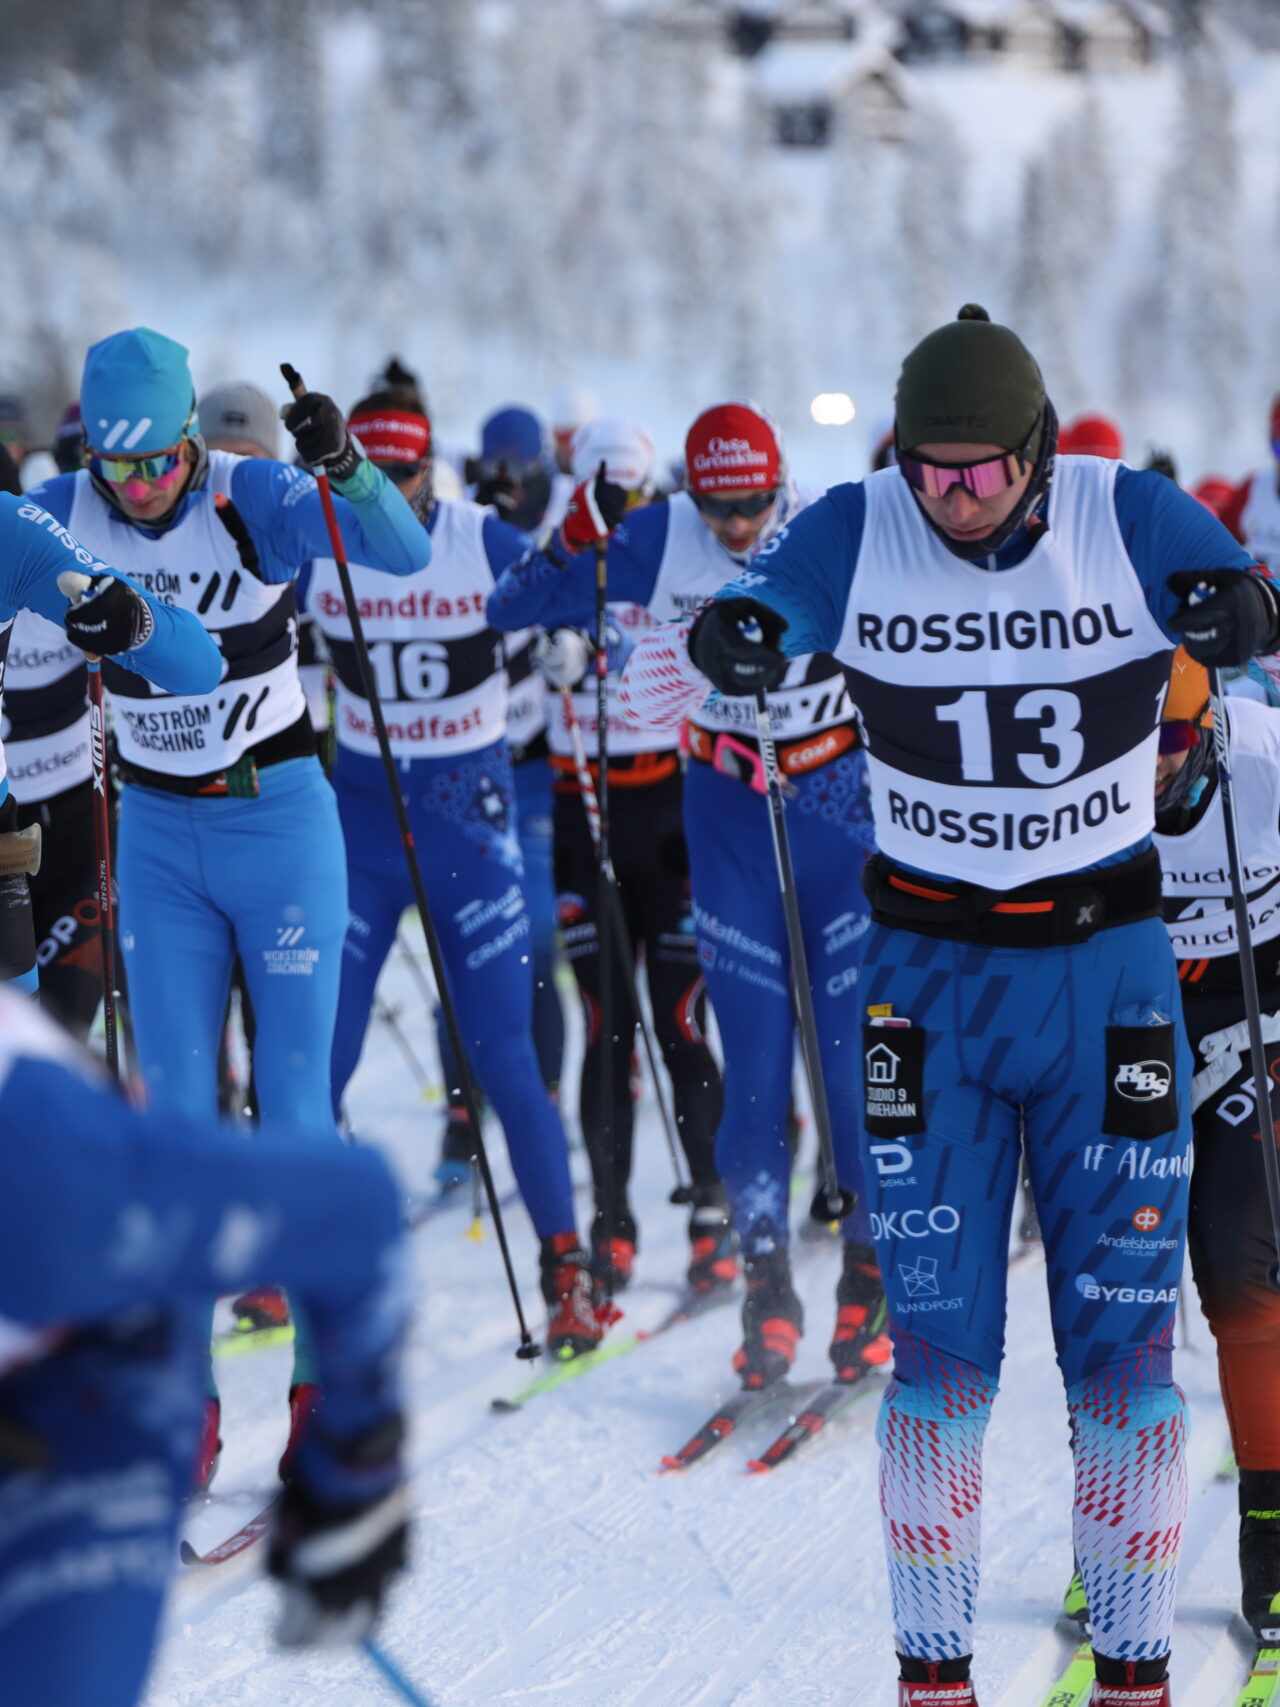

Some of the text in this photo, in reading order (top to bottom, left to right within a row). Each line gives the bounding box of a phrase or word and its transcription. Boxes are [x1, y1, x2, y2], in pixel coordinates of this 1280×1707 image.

[856, 603, 1133, 653] ROSSIGNOL
[370, 640, 450, 701] 16
[787, 736, 838, 768] COXA
[935, 688, 1085, 785] 13
[887, 781, 1131, 851] ROSSIGNOL
[898, 1087, 907, 1102] 9
[1117, 1064, 1170, 1099] RBS
[1083, 1140, 1194, 1180] IF Åland
[1096, 1232, 1179, 1251] Andelsbanken
[1097, 1687, 1165, 1700] MADSHUS
